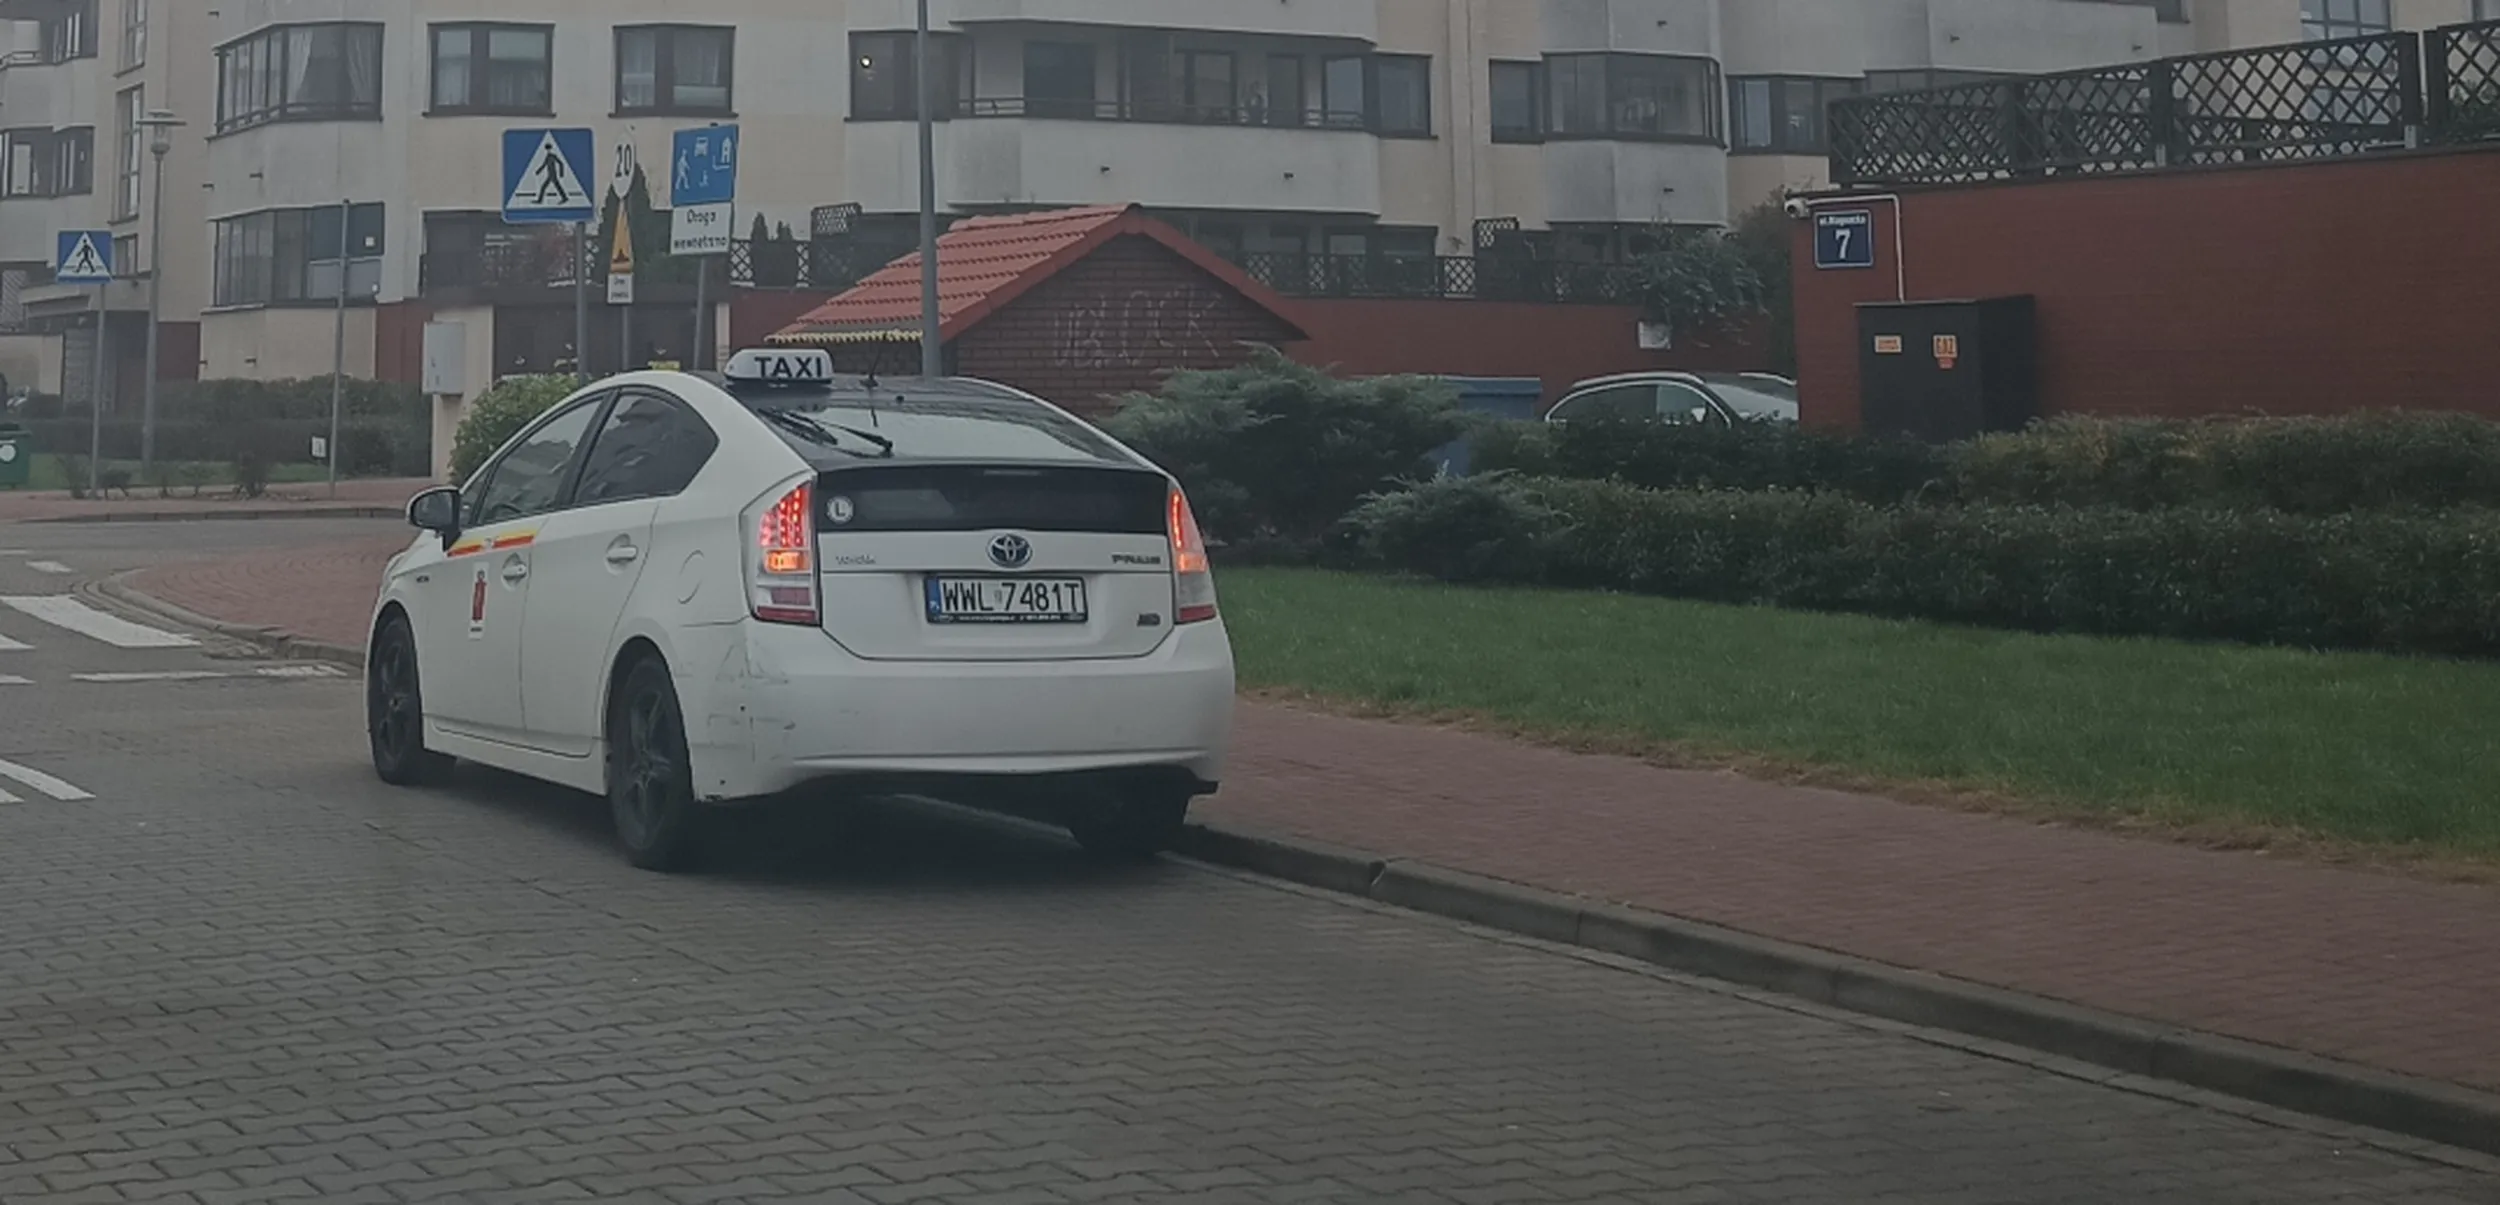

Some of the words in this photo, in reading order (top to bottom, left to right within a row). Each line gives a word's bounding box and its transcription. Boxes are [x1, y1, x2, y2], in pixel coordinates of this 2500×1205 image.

[615, 143, 632, 177] 20
[686, 208, 717, 226] Droga
[1835, 228, 1851, 259] 7
[754, 356, 823, 378] TAXI
[834, 501, 847, 517] L
[942, 581, 994, 612] WWL
[1001, 582, 1081, 613] 7481T
